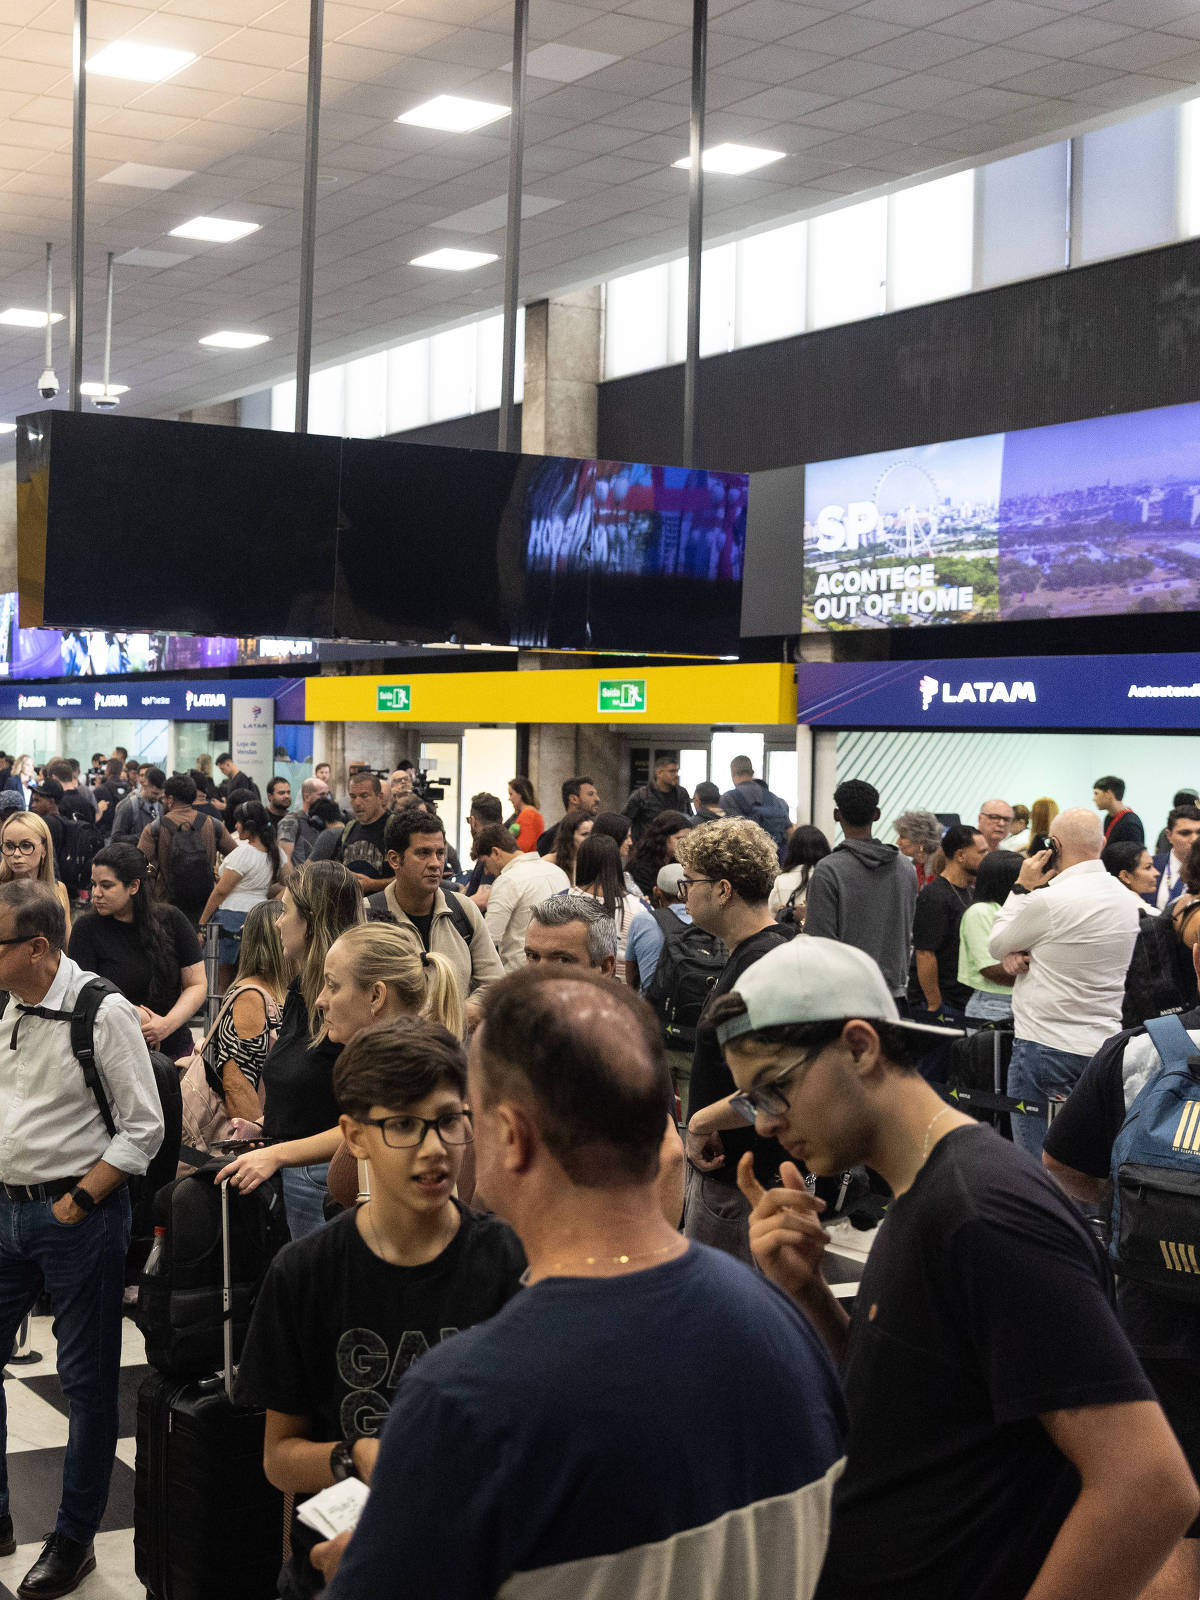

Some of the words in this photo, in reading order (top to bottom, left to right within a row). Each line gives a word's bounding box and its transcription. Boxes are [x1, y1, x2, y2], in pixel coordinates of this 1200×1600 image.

[816, 501, 879, 553] SP
[814, 564, 936, 596] ACONTECE
[813, 596, 861, 621] OUT
[864, 593, 896, 617] OF
[901, 587, 974, 614] HOME
[100, 694, 128, 707] LATAM
[193, 693, 226, 707] LATAM
[942, 682, 1037, 702] LATAM
